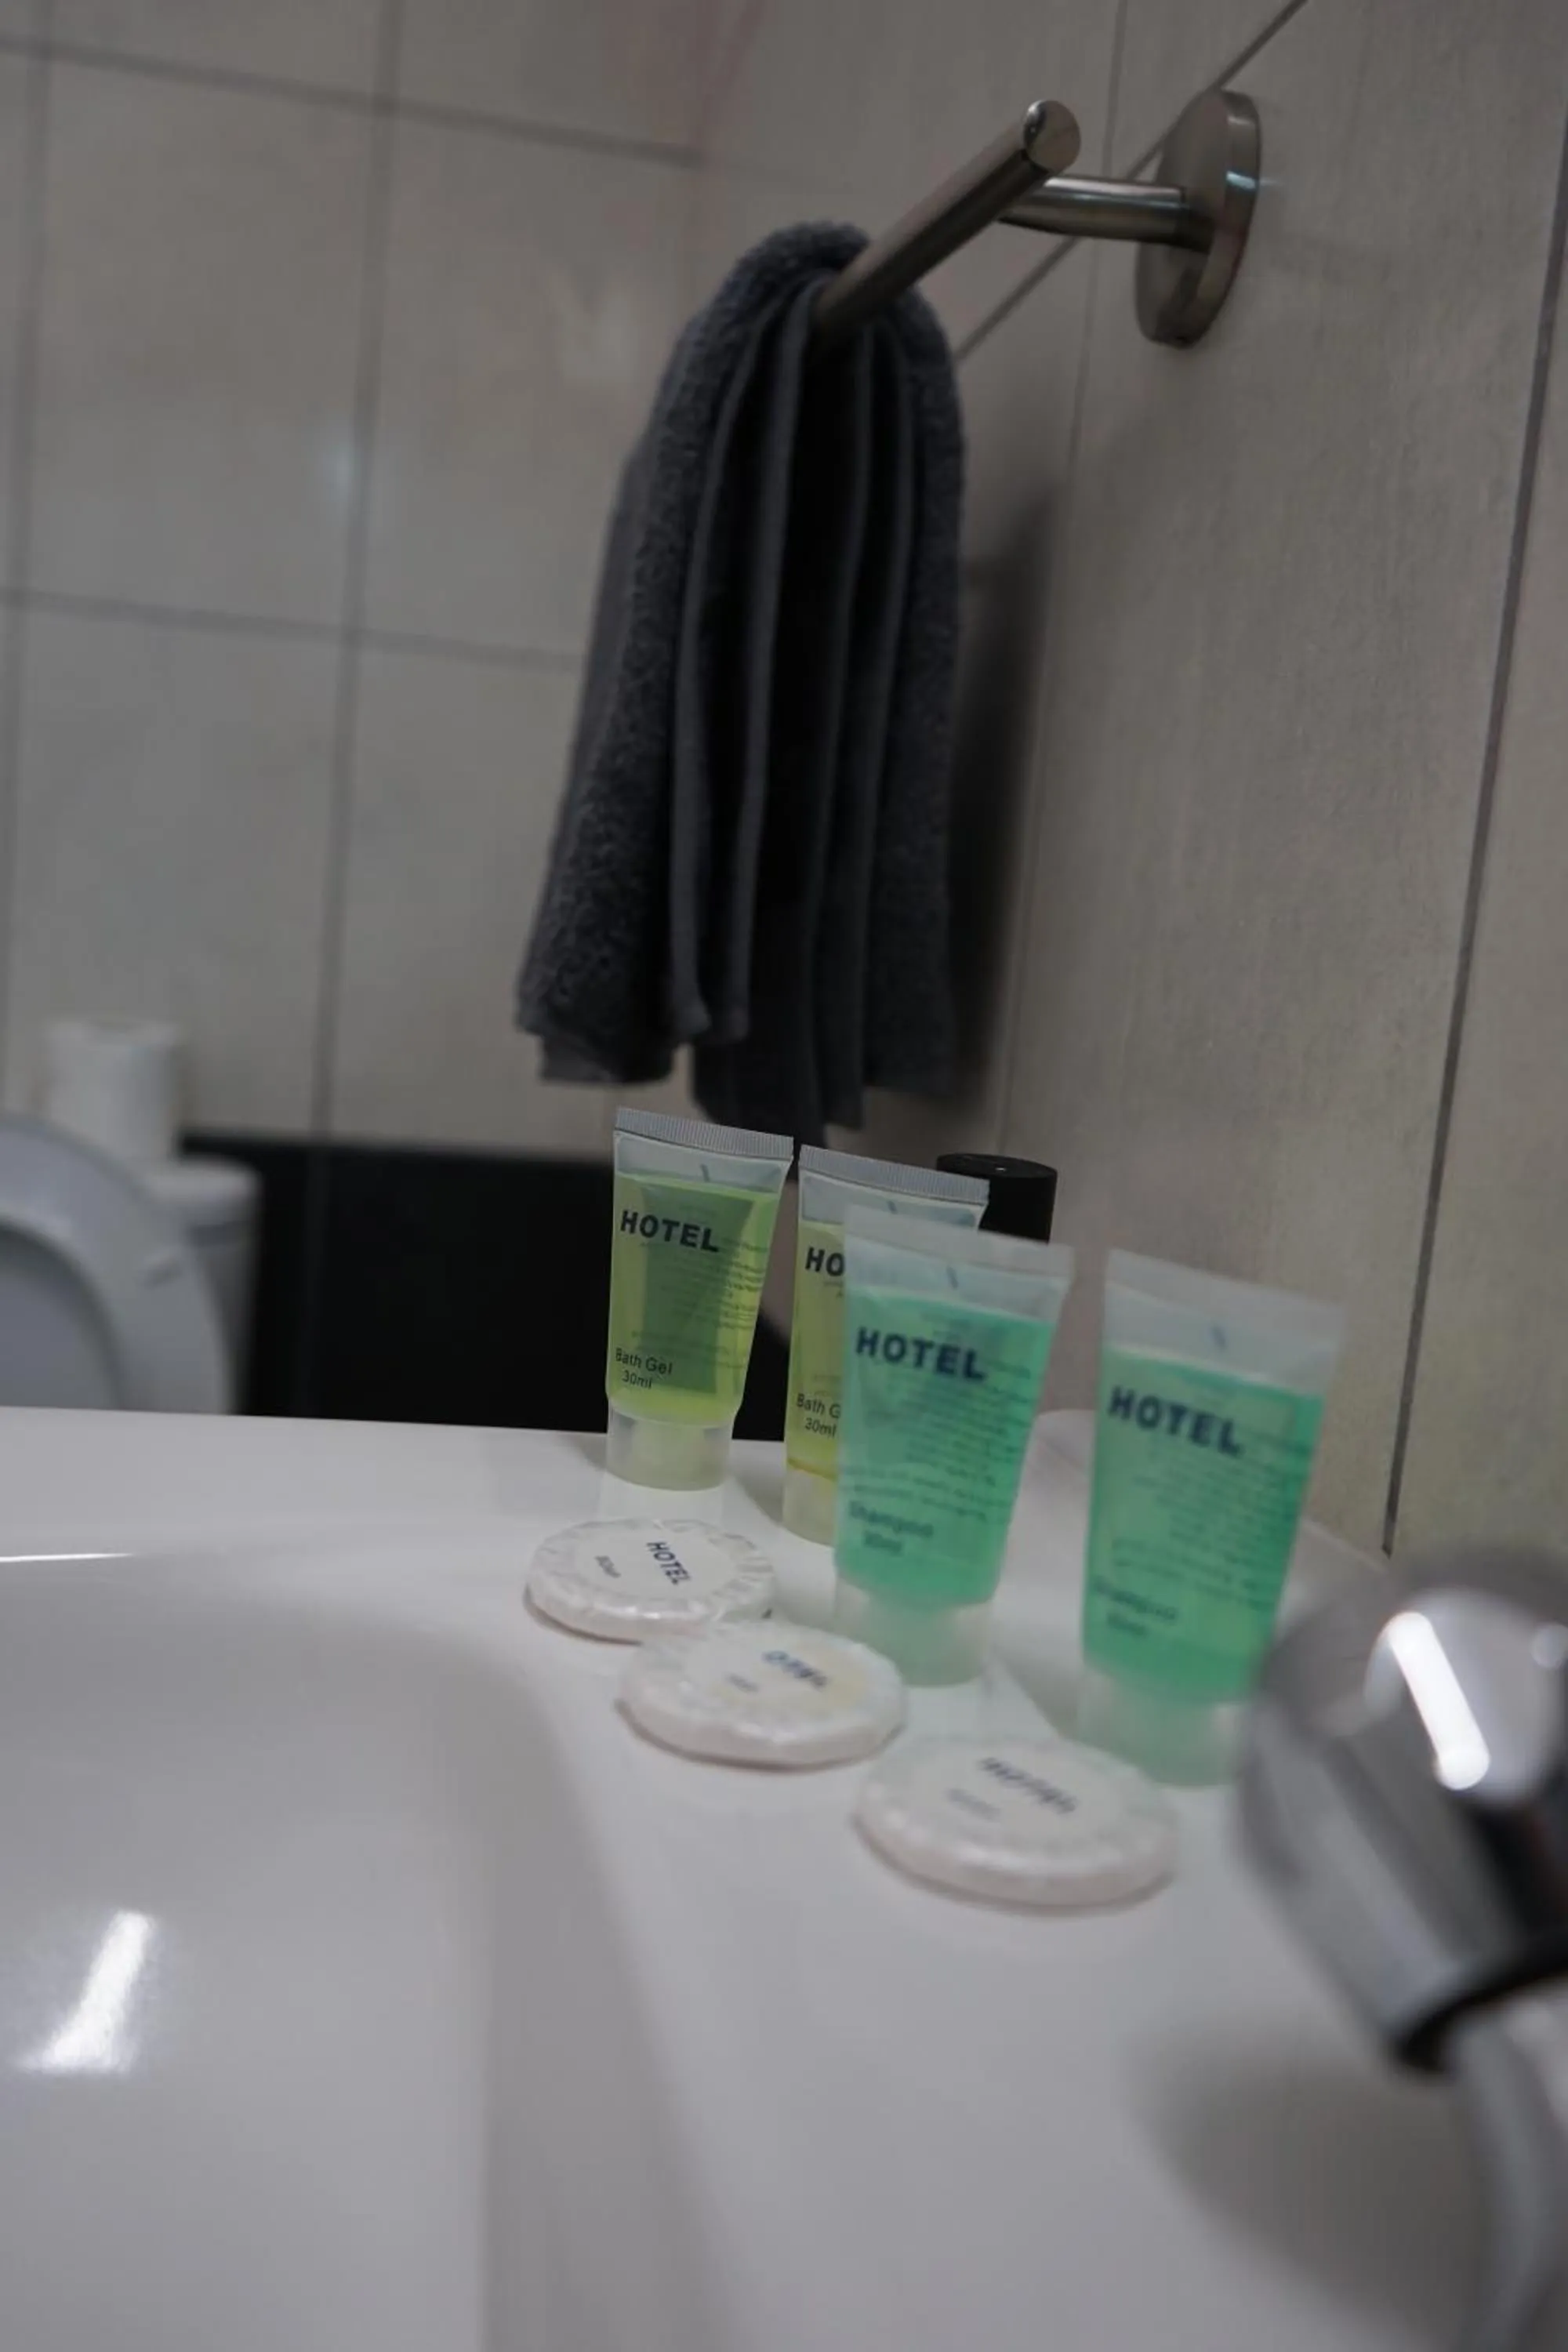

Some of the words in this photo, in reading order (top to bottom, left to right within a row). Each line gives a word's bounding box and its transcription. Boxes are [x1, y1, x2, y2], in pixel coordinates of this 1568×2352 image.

[620, 1210, 720, 1253] HOTEL
[615, 1347, 642, 1369] Bath
[645, 1357, 673, 1375] Gel
[855, 1325, 986, 1383] HOTEL
[622, 1370, 652, 1390] 30ml
[796, 1392, 826, 1416] Bath
[805, 1417, 837, 1439] 30ml
[1107, 1385, 1246, 1460] HOTEL
[645, 1541, 691, 1585] HOTEL
